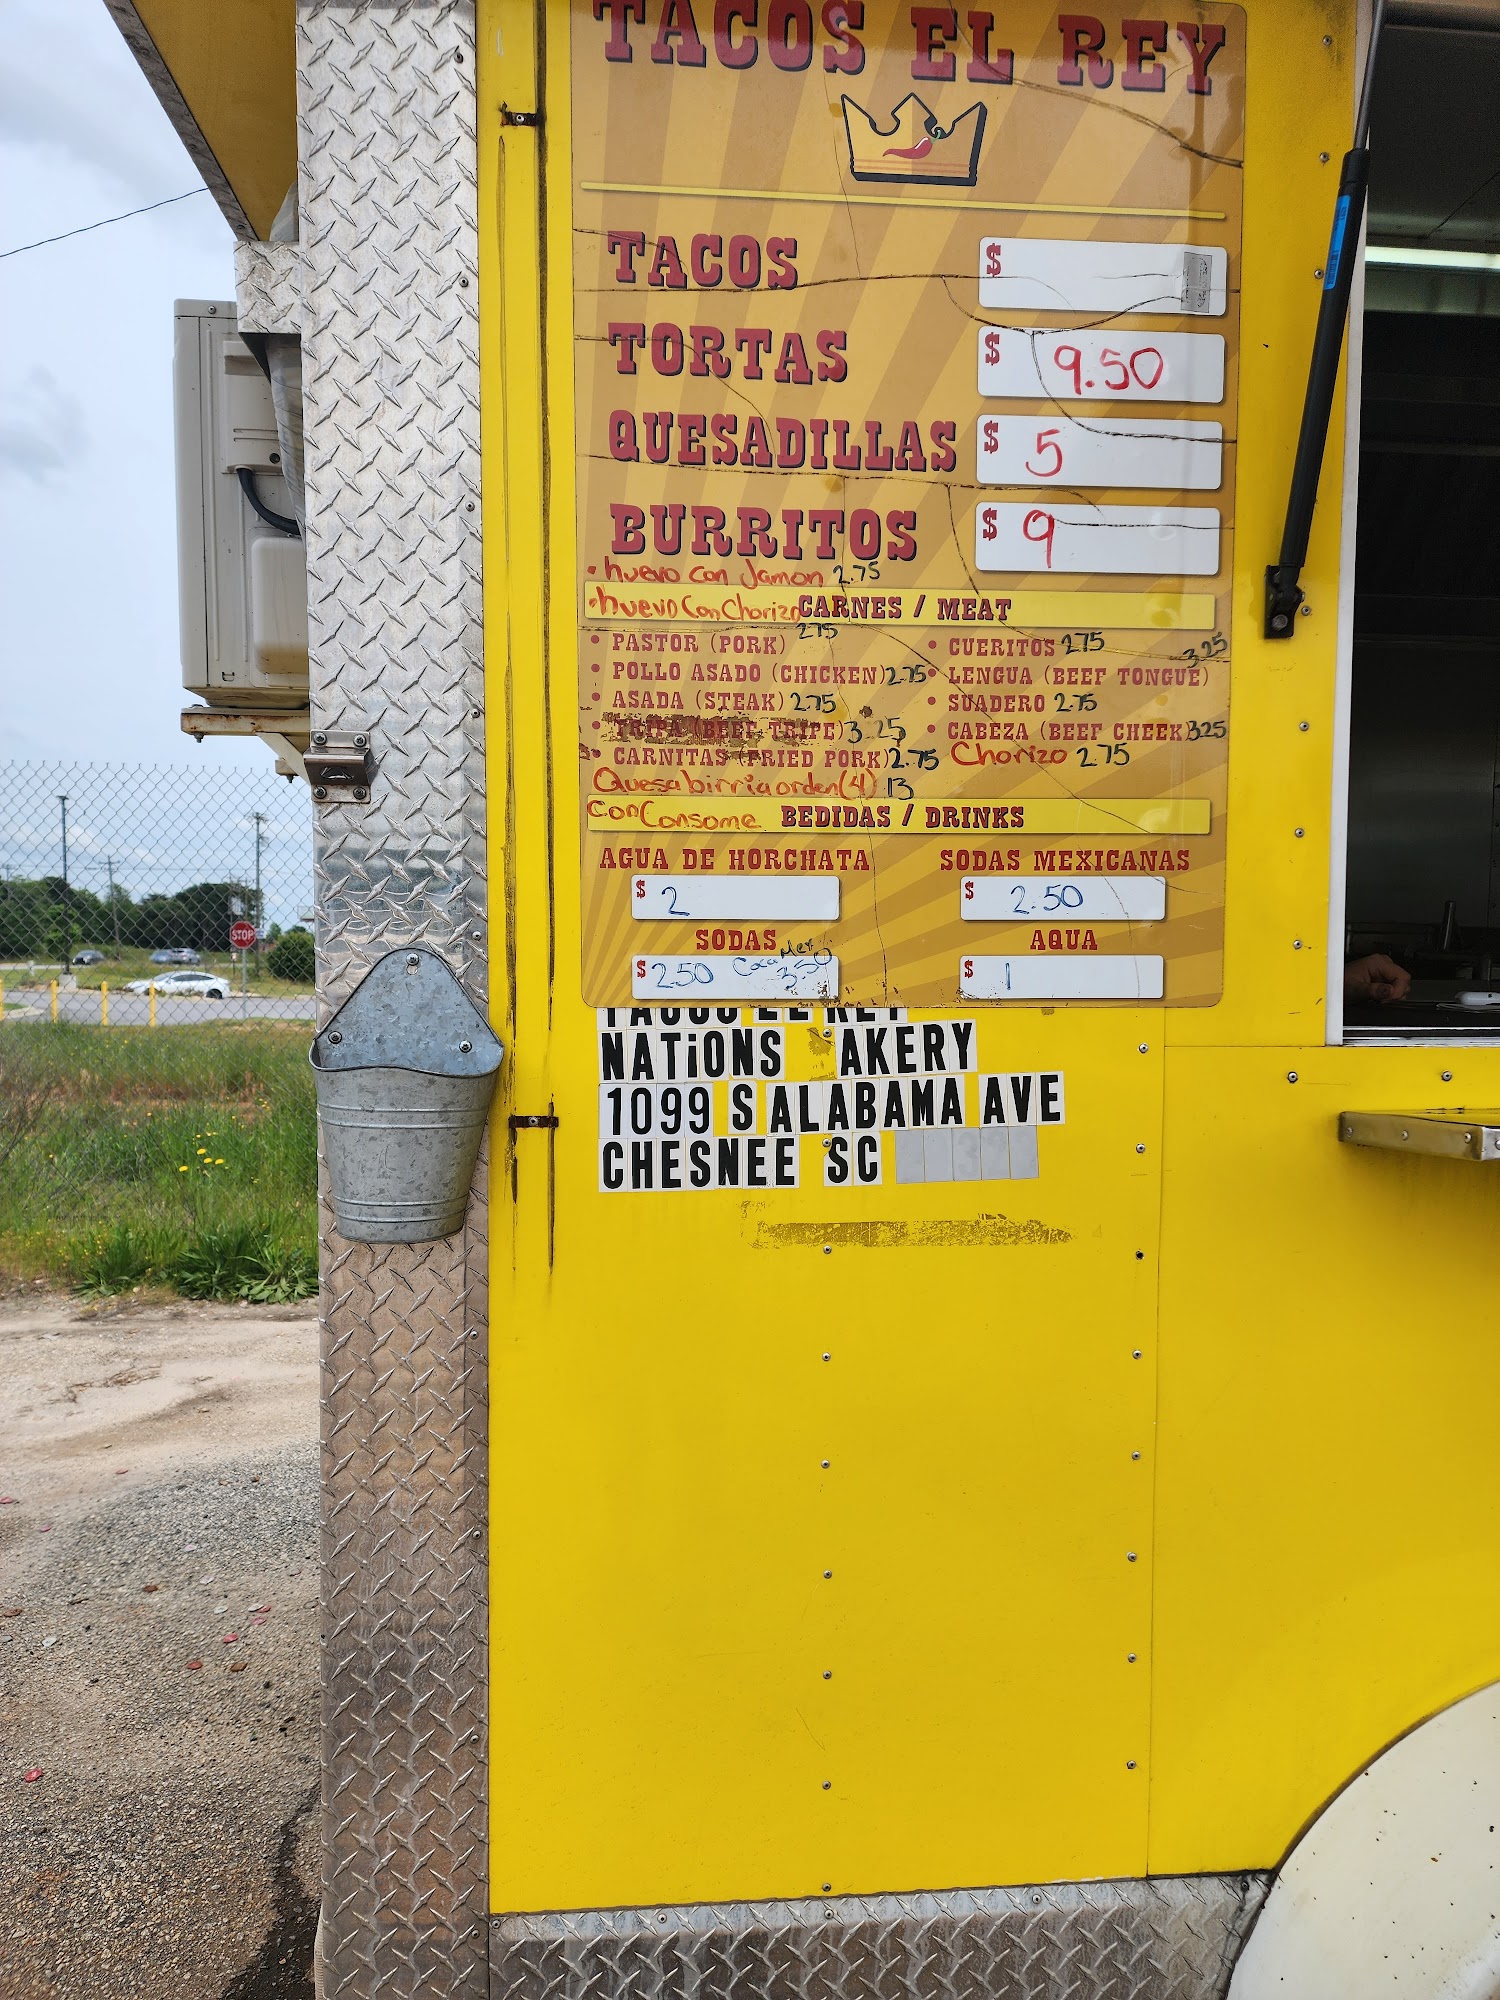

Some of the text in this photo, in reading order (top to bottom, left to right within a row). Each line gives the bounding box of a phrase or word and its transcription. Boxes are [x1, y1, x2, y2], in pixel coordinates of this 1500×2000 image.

[593, 0, 1226, 95] TACOS EL REY
[607, 231, 798, 290] TACOS
[986, 243, 1001, 277] $
[608, 322, 848, 385] TORTAS
[985, 332, 1164, 395] $ 9.50
[608, 410, 957, 472] QUESADILLAS
[984, 420, 1063, 477] $ 5
[609, 503, 918, 561] BURRITOS
[982, 508, 1055, 568] $ 9
[604, 556, 680, 583] huevo
[739, 558, 824, 590] Jamon
[832, 560, 881, 584] 2.75
[798, 594, 1012, 622] CARNES / MEAT
[612, 632, 786, 655] PASTOR (PORK)
[949, 637, 1055, 657] CUERITOS
[612, 661, 885, 685] POLLO ASADO (CHICKEN)
[949, 665, 1209, 687] LENGUA (BEEF TONGUE)
[612, 689, 784, 712] ASADA (STEAK)
[948, 694, 1045, 713] SUADERO
[769, 719, 844, 740] TRIPE)
[947, 720, 1192, 742] CABEZA (BEEF CHEEK)
[613, 746, 889, 768] CARNITAS (FRIED PORK)
[888, 747, 940, 771] 2.75
[951, 741, 1067, 766] Chorizo
[781, 804, 1024, 828] BEDIDAS / DRINKS
[600, 848, 870, 871] AGUA DE HORCHATA
[940, 850, 1190, 871] SODAS MEXICANAS
[636, 880, 690, 916] $ 2
[965, 881, 1084, 914] $ 2.50
[231, 929, 255, 941] STOP
[696, 930, 776, 950] SODAS
[1030, 930, 1098, 950] AQUA
[637, 960, 646, 978] $
[965, 960, 973, 978] $
[606, 1074, 1061, 1136] 1099 S ALABAMA AVE
[602, 1135, 877, 1190] CHESNEE SC
